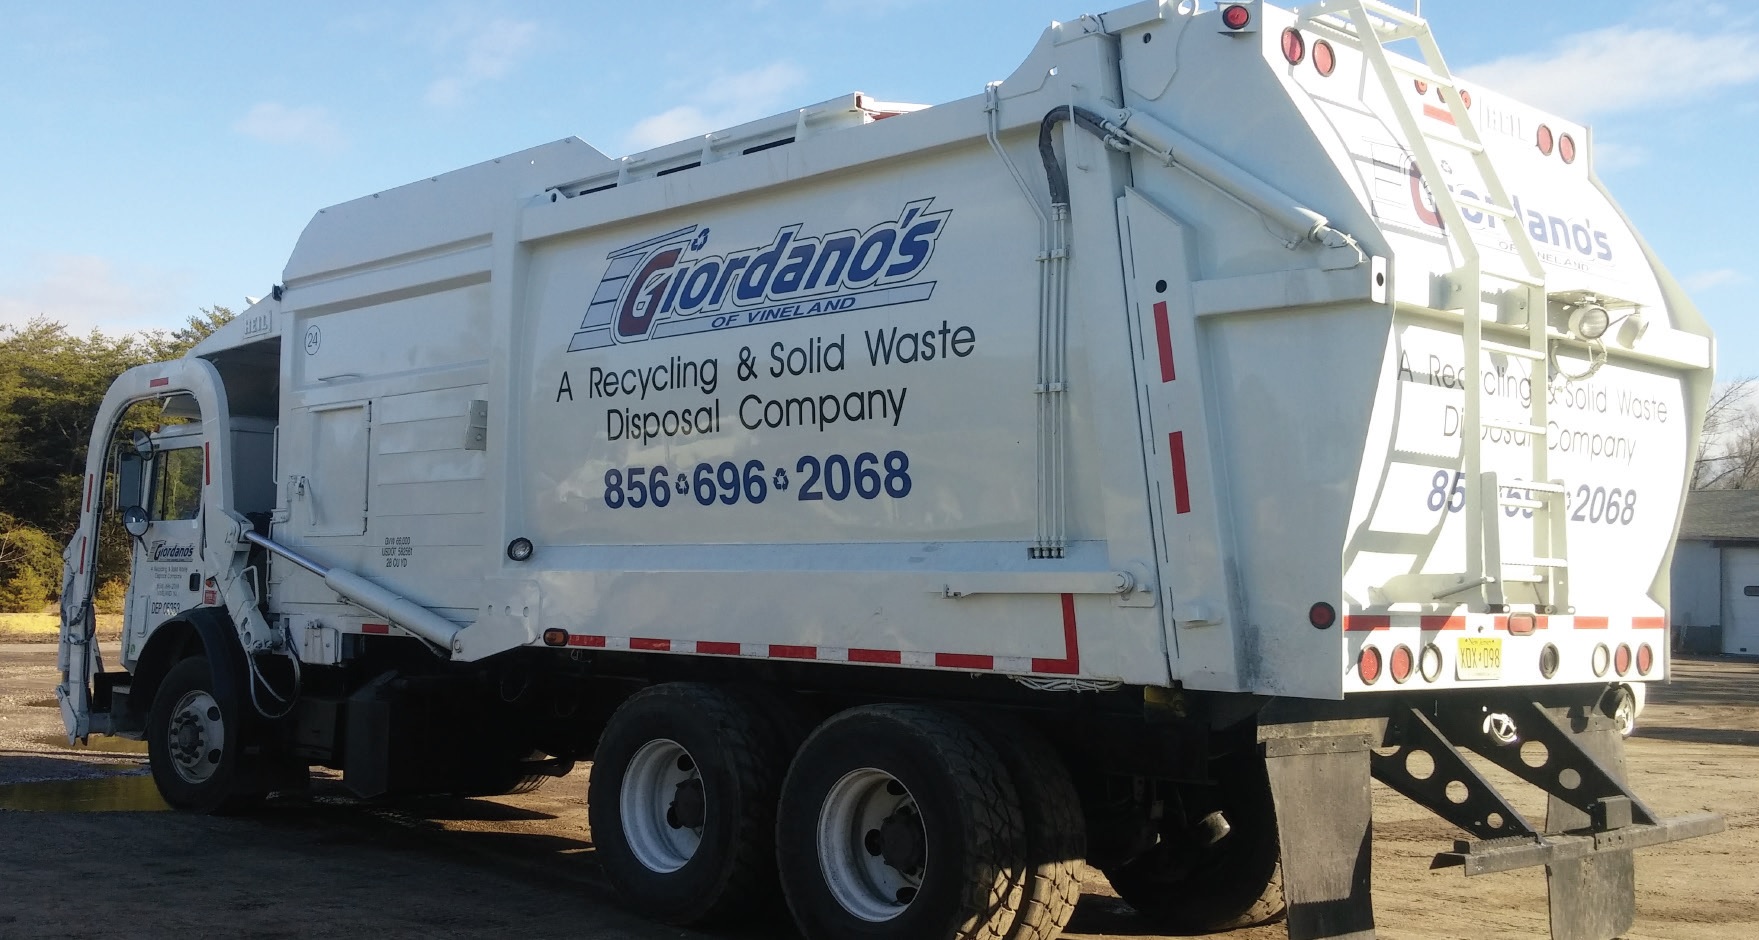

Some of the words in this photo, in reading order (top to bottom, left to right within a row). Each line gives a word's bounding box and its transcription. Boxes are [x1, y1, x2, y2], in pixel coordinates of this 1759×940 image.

[617, 208, 942, 337] Giordano's
[245, 315, 268, 335] HEIL
[308, 332, 318, 348] 24
[711, 314, 739, 329] OF
[748, 297, 856, 323] VINELAND
[557, 371, 573, 402] A
[589, 355, 718, 400] Recycling
[737, 346, 758, 381] &
[770, 333, 845, 378] Solid
[865, 320, 976, 366] Waste
[1397, 350, 1414, 382] A
[1430, 354, 1532, 409] Reccling
[1566, 380, 1607, 414] Solid
[1618, 388, 1668, 424] Waste
[607, 398, 719, 446] Disposal
[739, 387, 907, 431] Company
[1547, 420, 1637, 466] Company
[604, 466, 670, 509] 856
[693, 460, 767, 506] 696
[796, 450, 912, 500] 2068
[1427, 470, 1467, 513] 85
[1570, 484, 1637, 525] 2068
[154, 544, 194, 560] Giordano's
